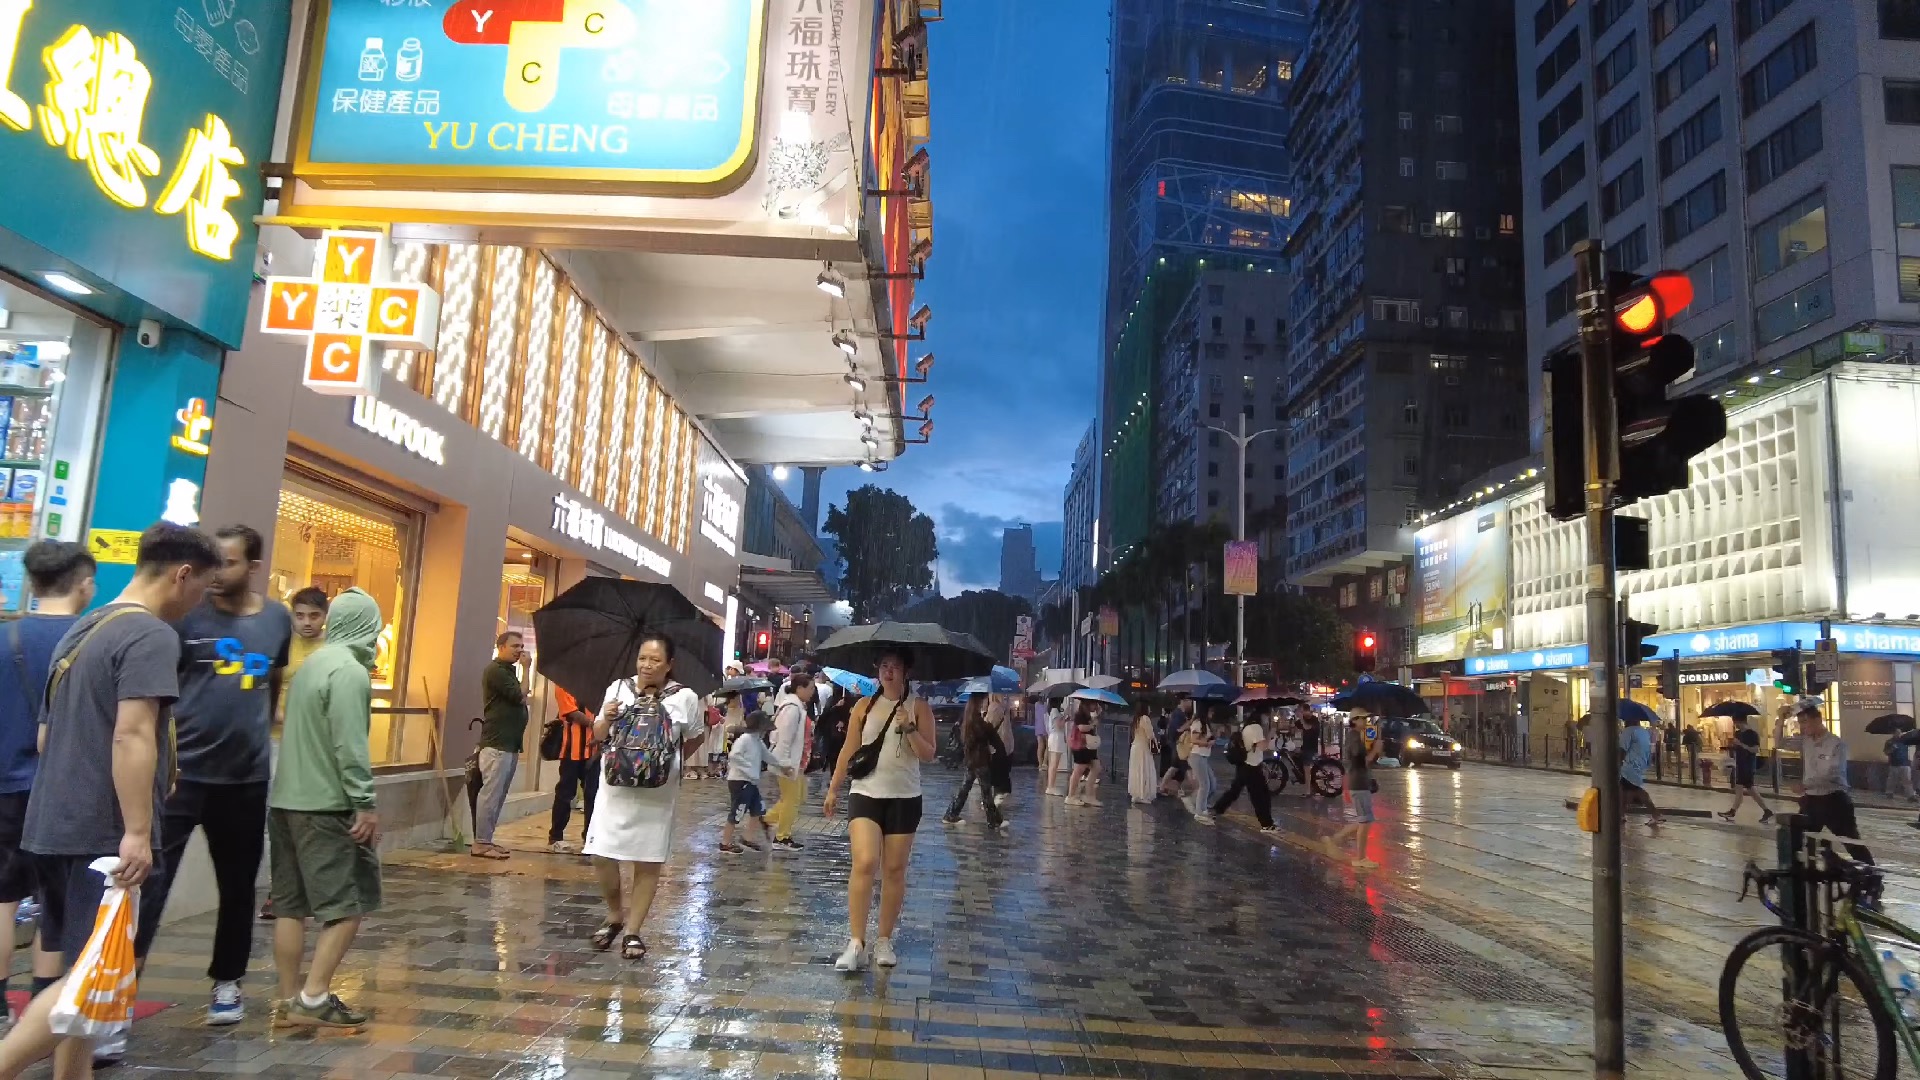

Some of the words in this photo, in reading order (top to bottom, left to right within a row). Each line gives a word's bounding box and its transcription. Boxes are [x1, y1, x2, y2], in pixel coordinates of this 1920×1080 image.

[470, 10, 494, 33] Y
[584, 12, 606, 34] C
[520, 61, 542, 83] C
[331, 88, 441, 116] 保健產品
[422, 121, 477, 151] YU
[486, 122, 629, 154] CHENG
[338, 244, 365, 277] Y
[281, 289, 308, 321] Y
[379, 295, 408, 328] C
[321, 341, 351, 374] C
[1714, 632, 1759, 652] shama
[1856, 628, 1920, 651] shama
[1545, 652, 1573, 666] shama
[1679, 672, 1729, 684] GIORDANO
